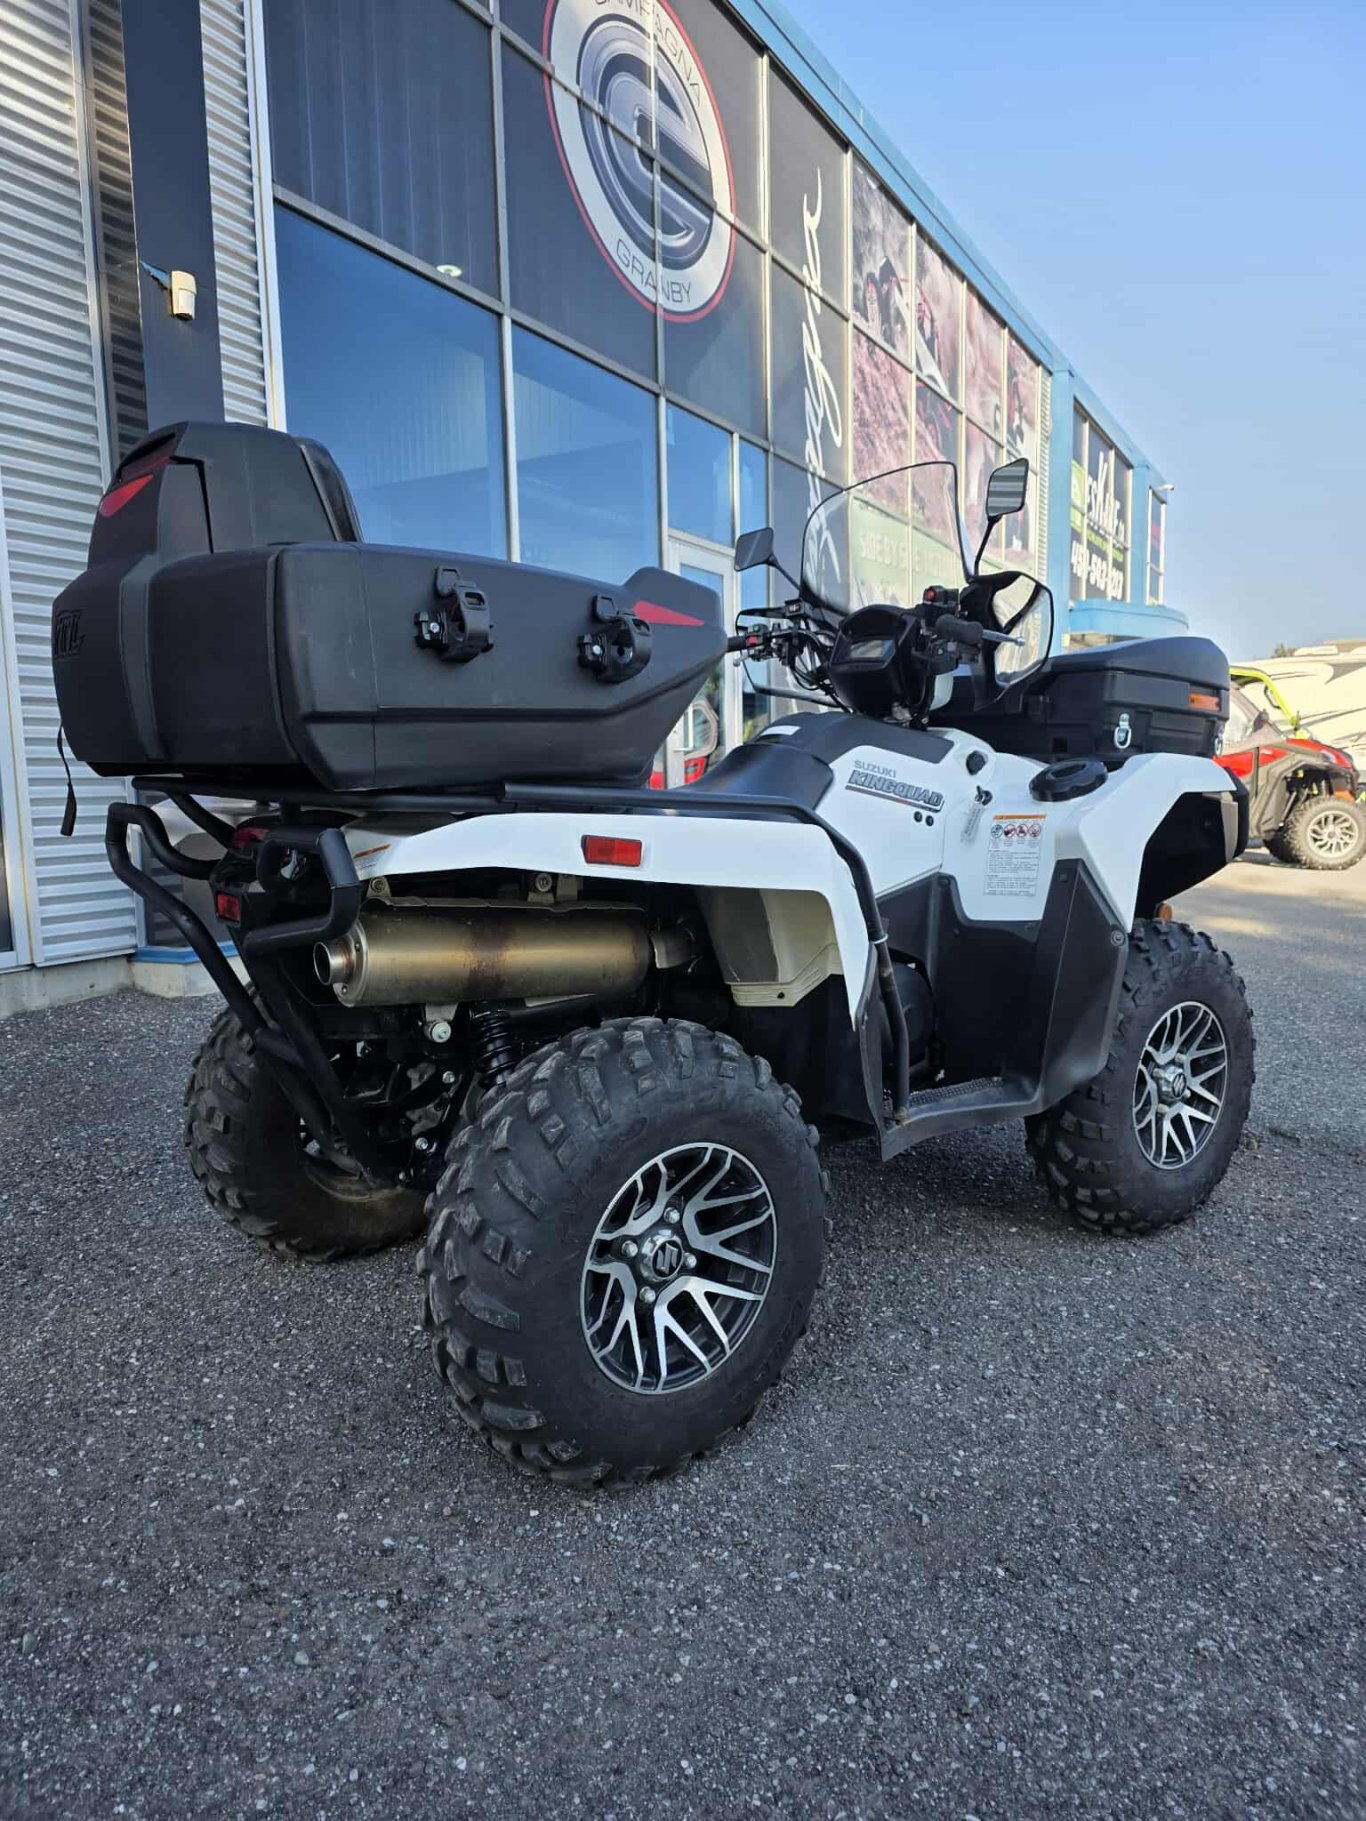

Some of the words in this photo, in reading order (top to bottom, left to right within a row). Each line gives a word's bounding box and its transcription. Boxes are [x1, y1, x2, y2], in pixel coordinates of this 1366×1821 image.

[616, 237, 692, 304] GRANBY
[848, 769, 944, 807] KINGQUAD
[854, 760, 897, 778] SUZUKI
